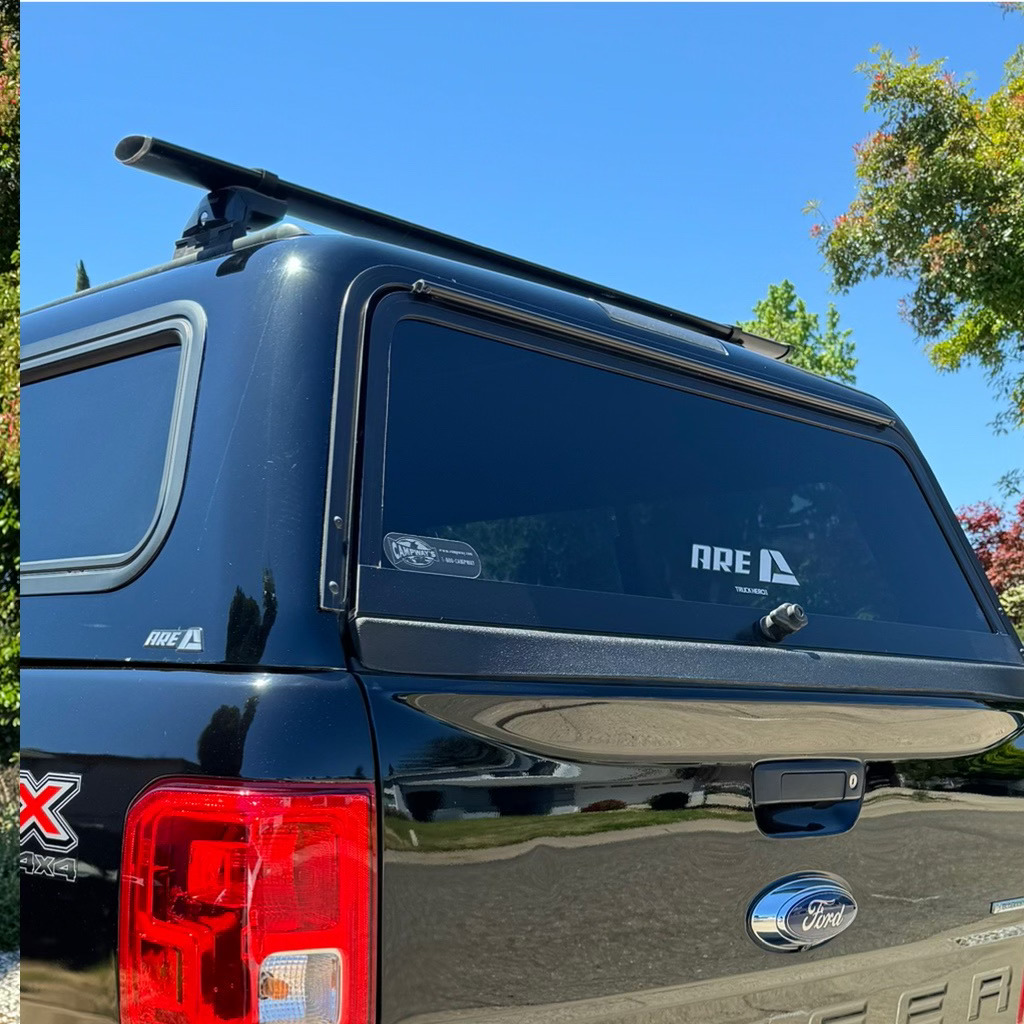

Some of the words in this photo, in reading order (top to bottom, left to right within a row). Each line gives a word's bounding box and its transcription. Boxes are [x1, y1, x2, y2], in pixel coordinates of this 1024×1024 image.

[691, 544, 751, 575] ARE
[144, 631, 182, 646] ARE
[802, 899, 845, 931] Ford
